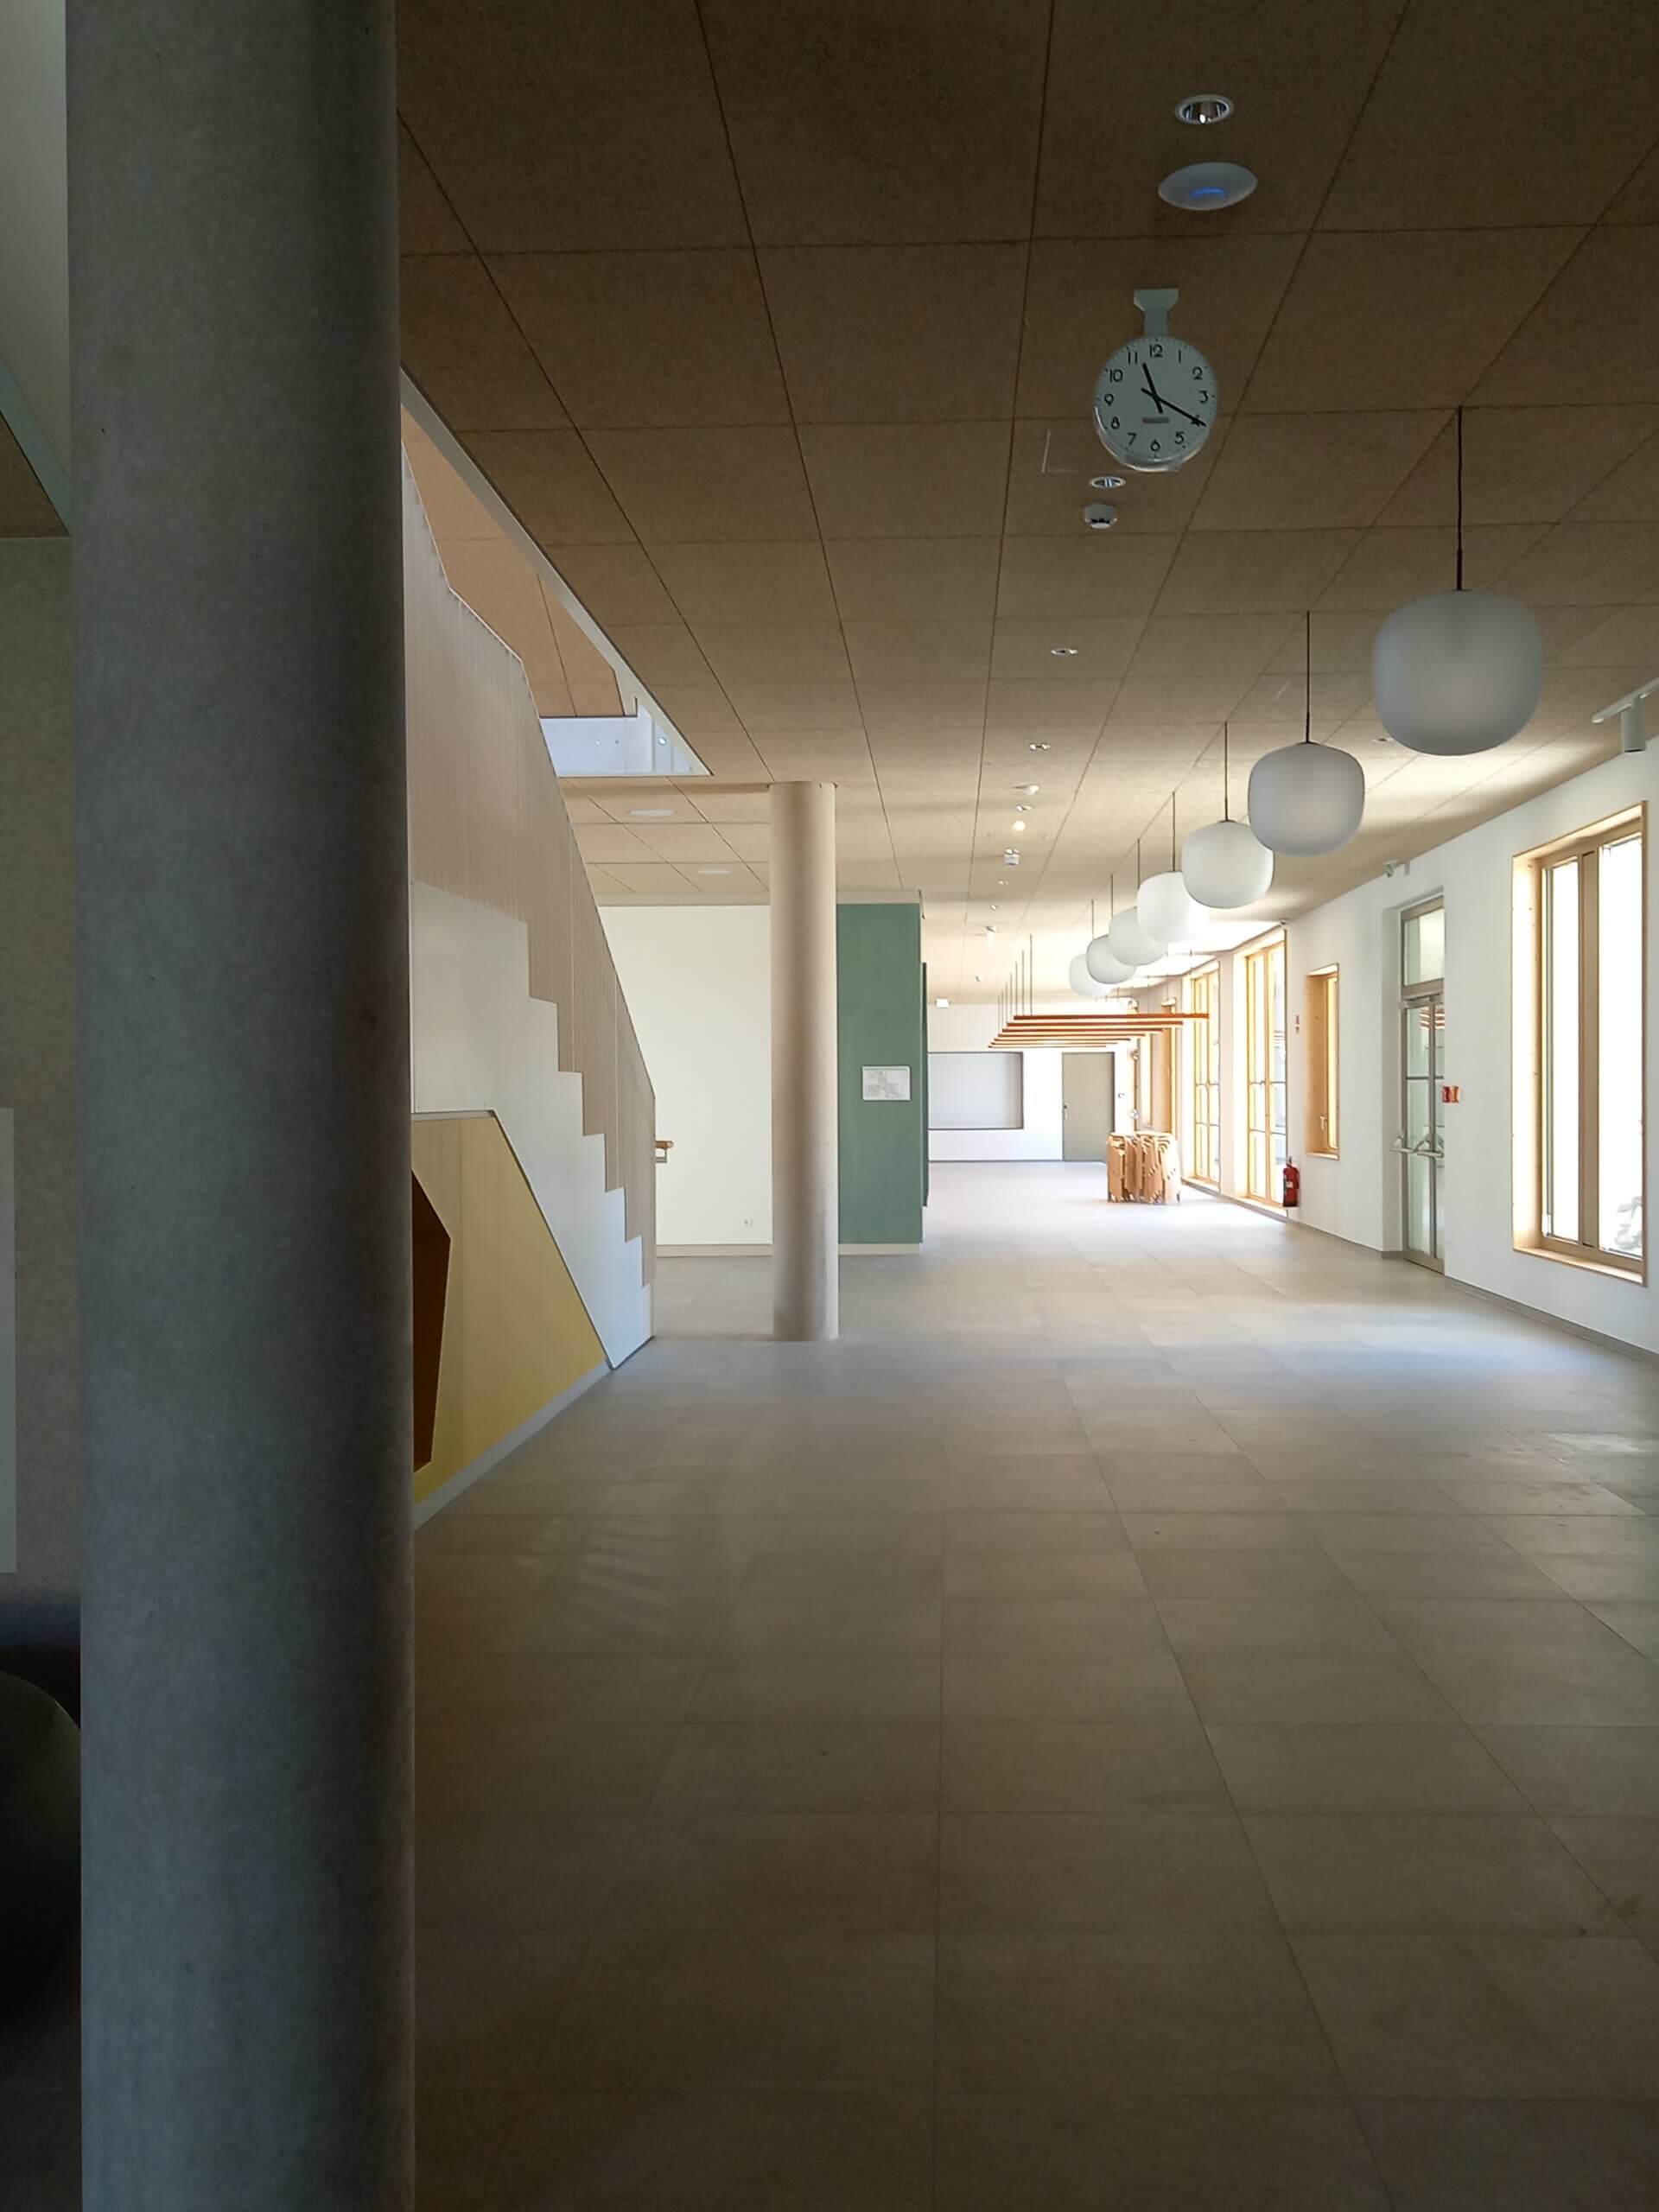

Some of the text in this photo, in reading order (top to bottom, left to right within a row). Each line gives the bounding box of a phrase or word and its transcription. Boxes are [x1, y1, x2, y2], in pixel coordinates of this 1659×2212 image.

[1149, 344, 1163, 358] 12
[1128, 351, 1138, 365] 11
[1109, 369, 1123, 383] 10
[1192, 366, 1203, 380] 2
[1104, 393, 1114, 406] 9
[1199, 391, 1209, 404] 3
[1110, 416, 1120, 429] 8
[1127, 433, 1137, 446] 7
[1174, 432, 1185, 444] 5
[1150, 439, 1160, 452] 6
